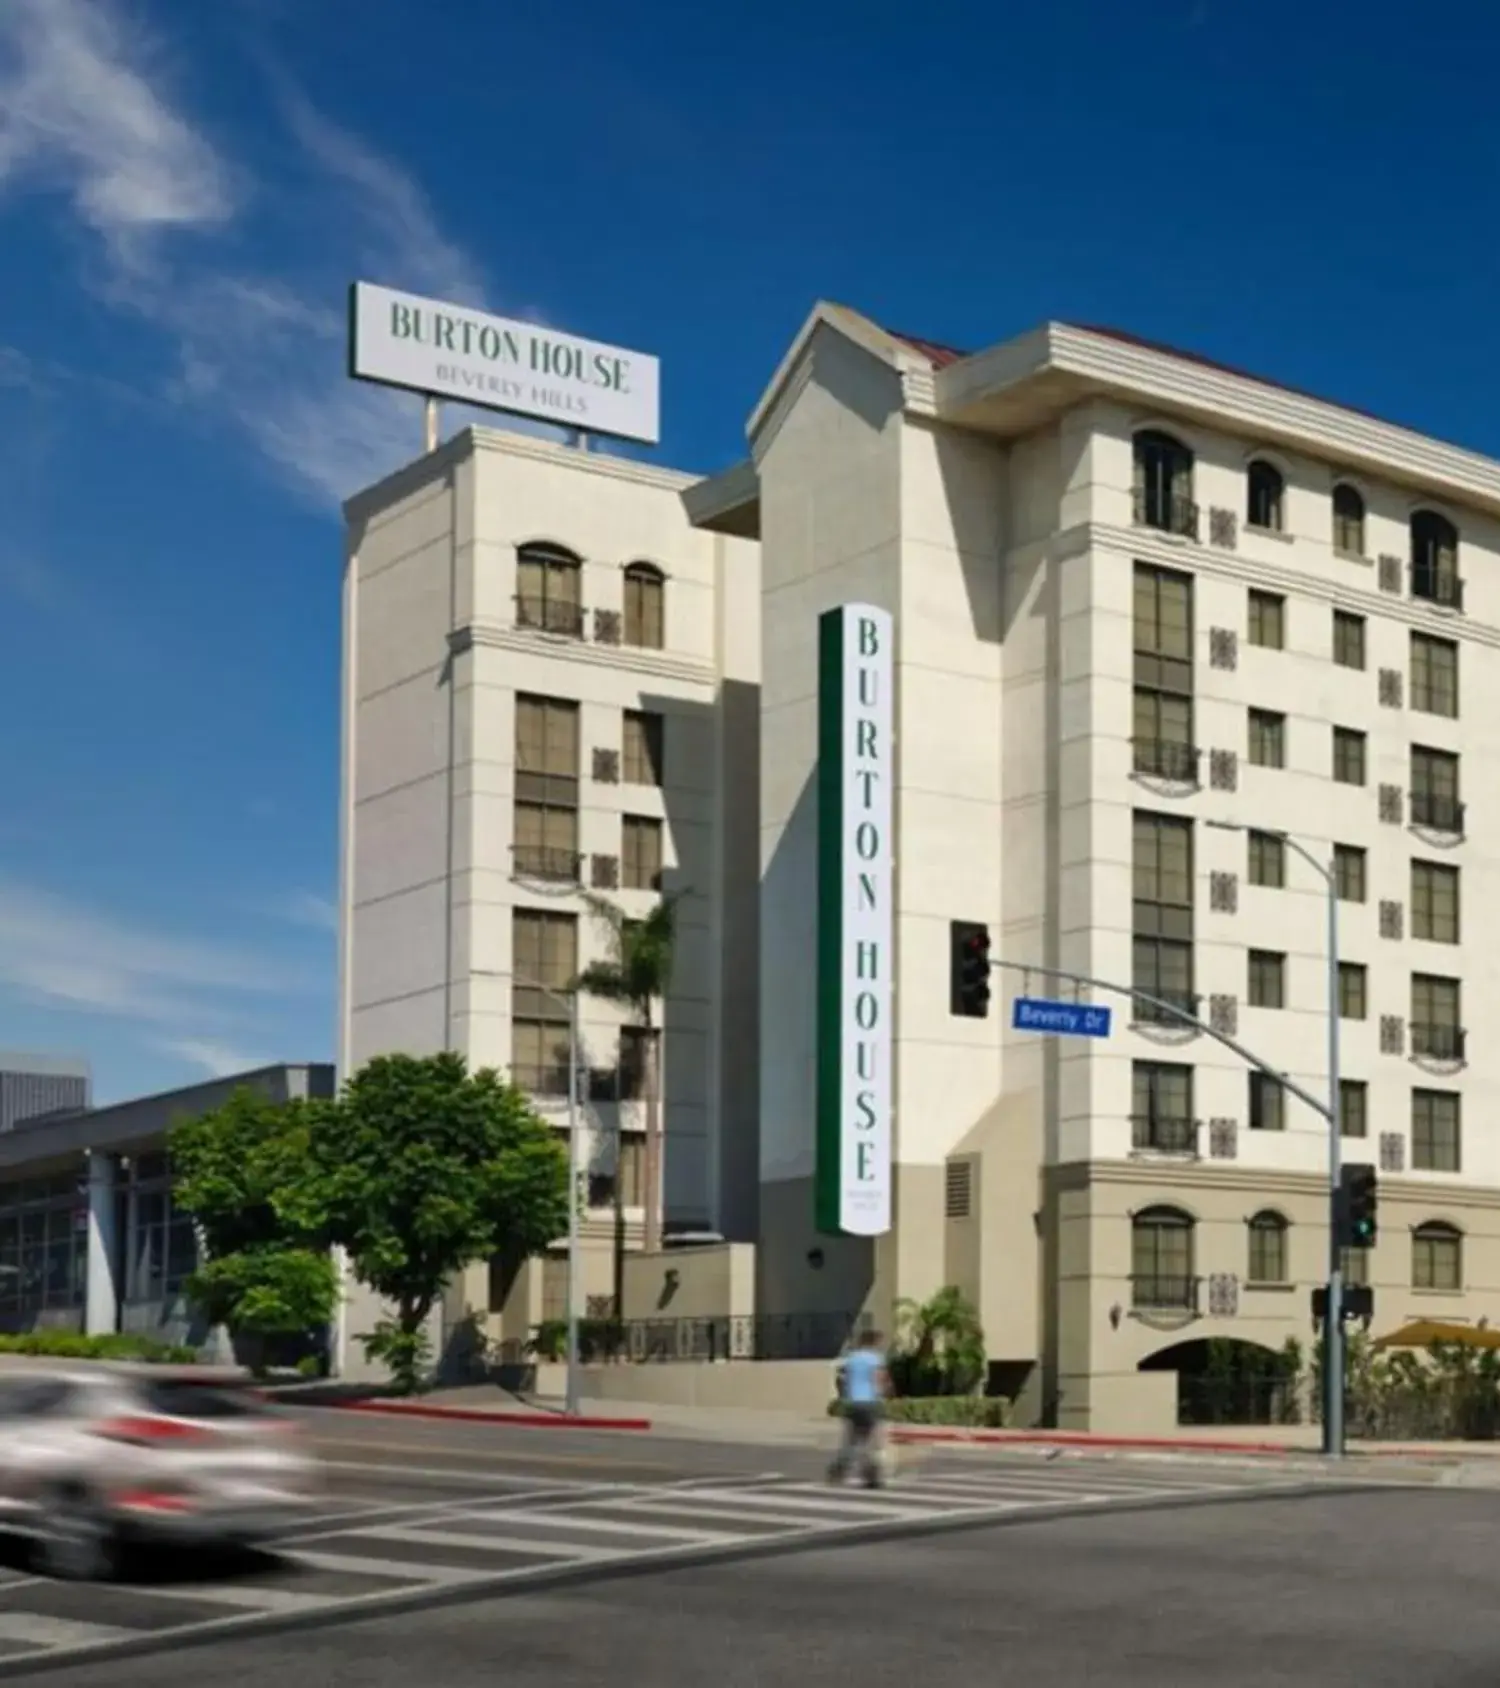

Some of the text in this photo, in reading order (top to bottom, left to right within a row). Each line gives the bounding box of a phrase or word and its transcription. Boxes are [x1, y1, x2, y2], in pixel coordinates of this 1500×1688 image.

[391, 302, 631, 393] BURTON HOUSE
[436, 364, 588, 413] BEVERLY HILLS
[855, 617, 878, 912] BURTON
[855, 940, 878, 1182] HOUSE
[1021, 1004, 1104, 1029] Beverly Dr
